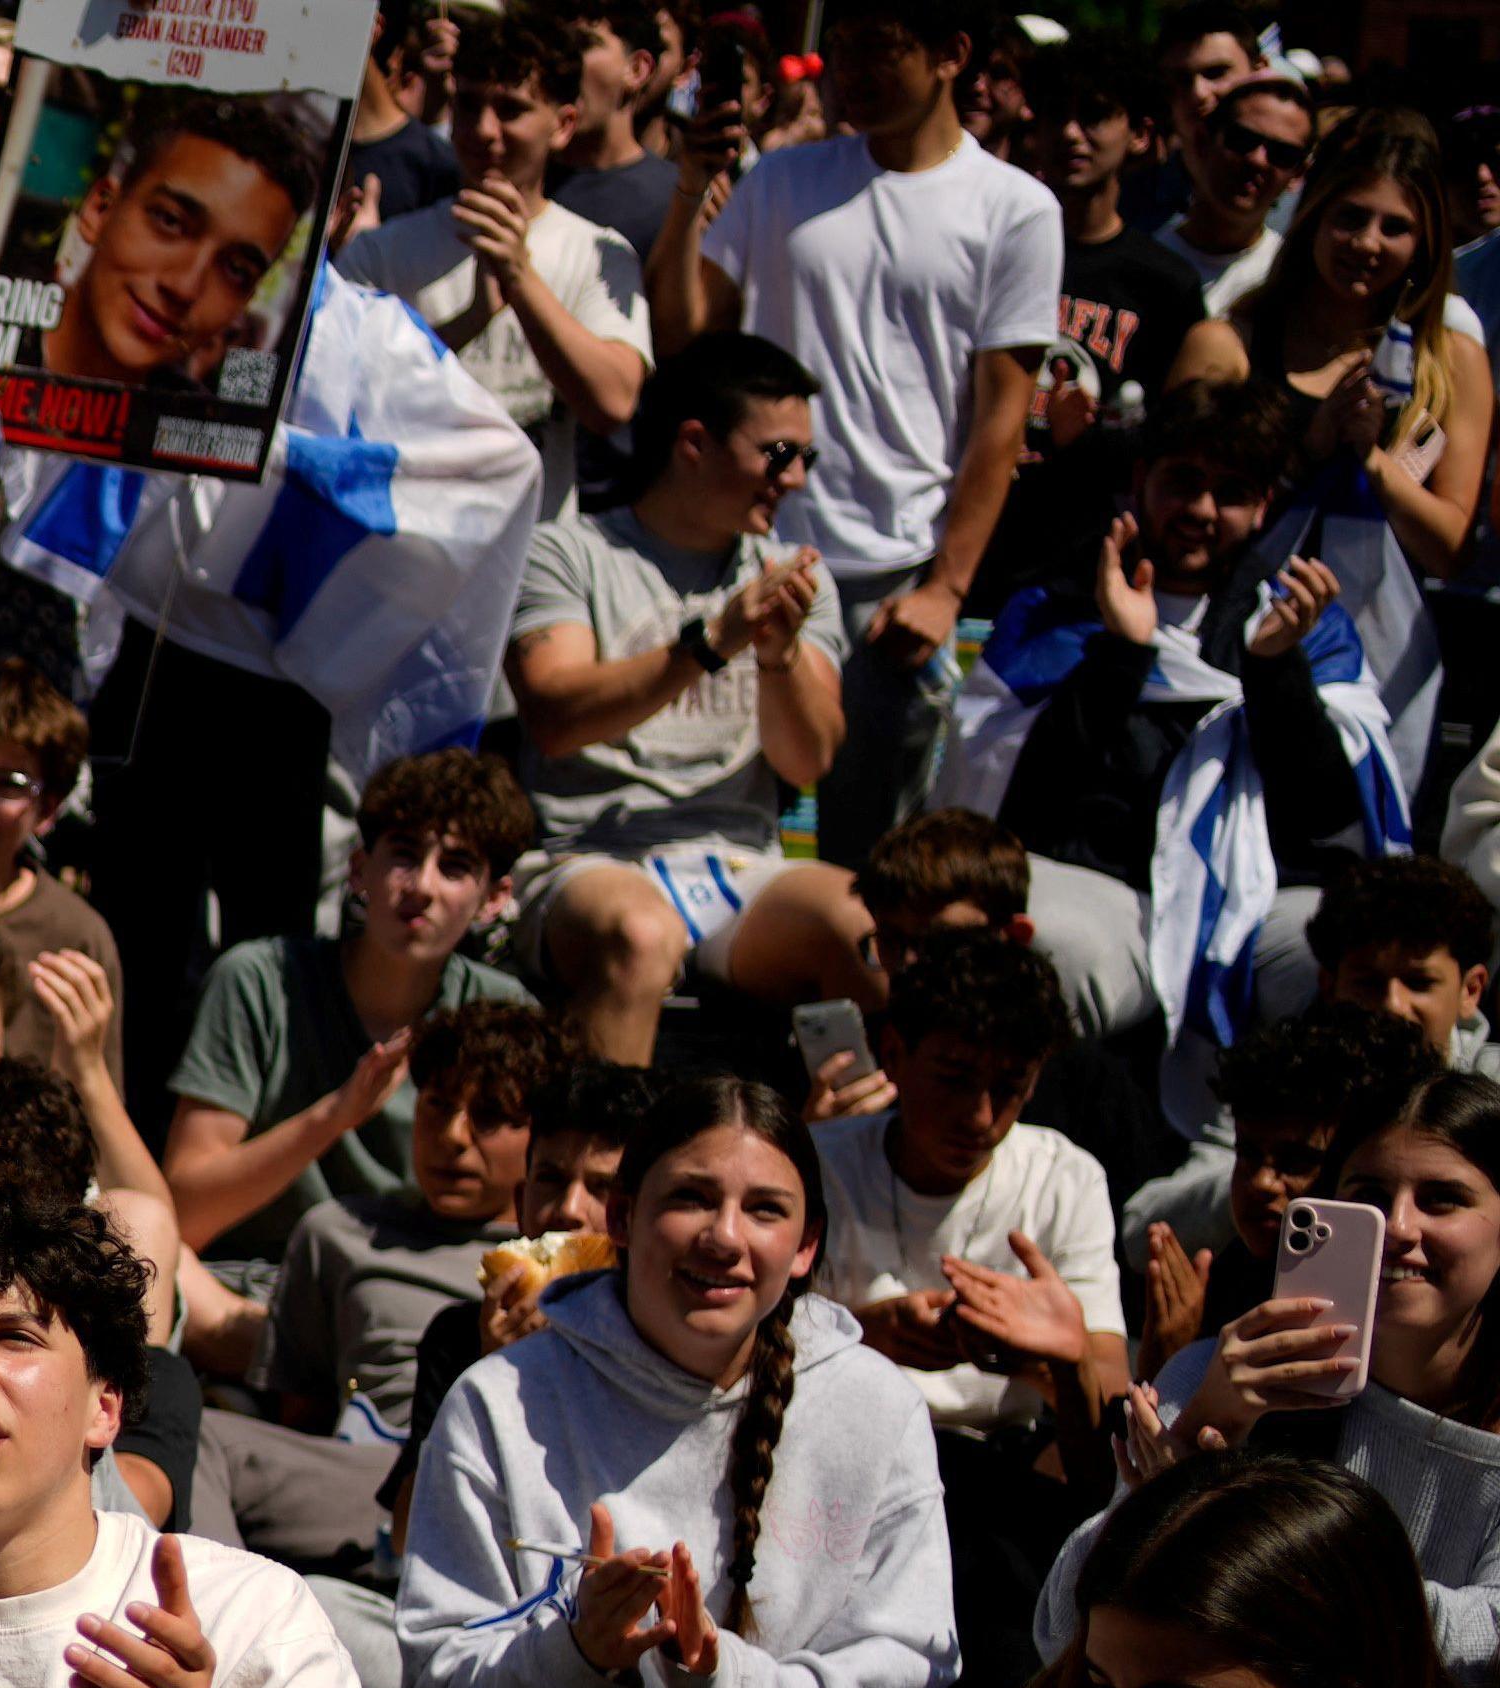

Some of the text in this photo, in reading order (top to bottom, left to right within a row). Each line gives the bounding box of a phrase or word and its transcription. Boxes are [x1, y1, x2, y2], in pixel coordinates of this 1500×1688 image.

[116, 13, 267, 54] EDAN ALEXANDER
[37, 383, 131, 440] NOW!
